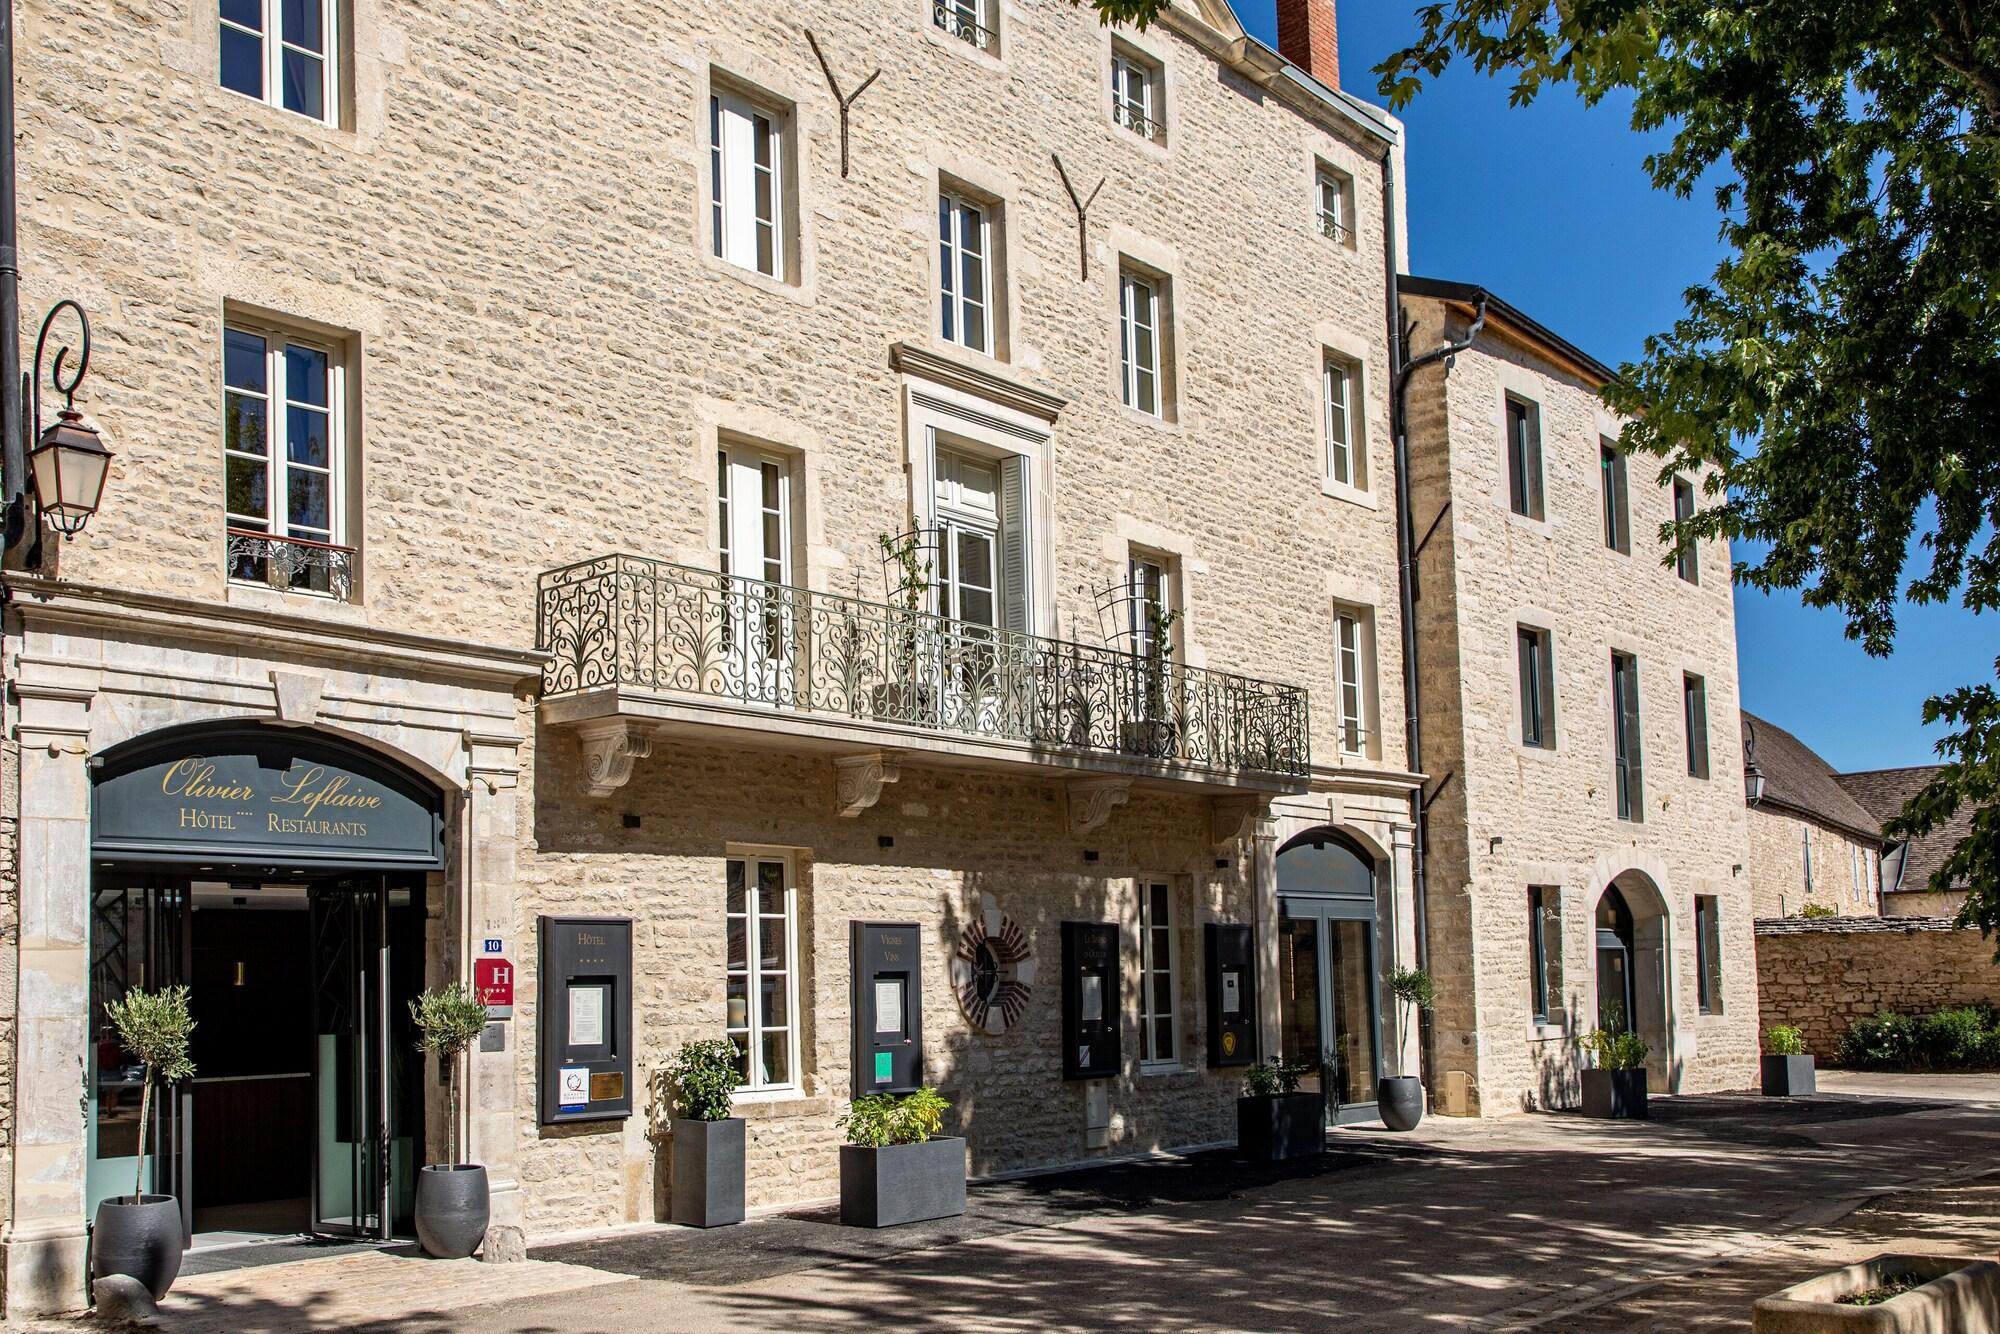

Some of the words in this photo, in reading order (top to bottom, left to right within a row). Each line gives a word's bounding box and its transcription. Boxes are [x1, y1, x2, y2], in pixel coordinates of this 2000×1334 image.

[163, 755, 255, 800] Olivier
[270, 767, 381, 817] Leflaive
[267, 813, 367, 836] RESTAURANTS
[488, 941, 499, 950] 10
[492, 968, 510, 984] H
